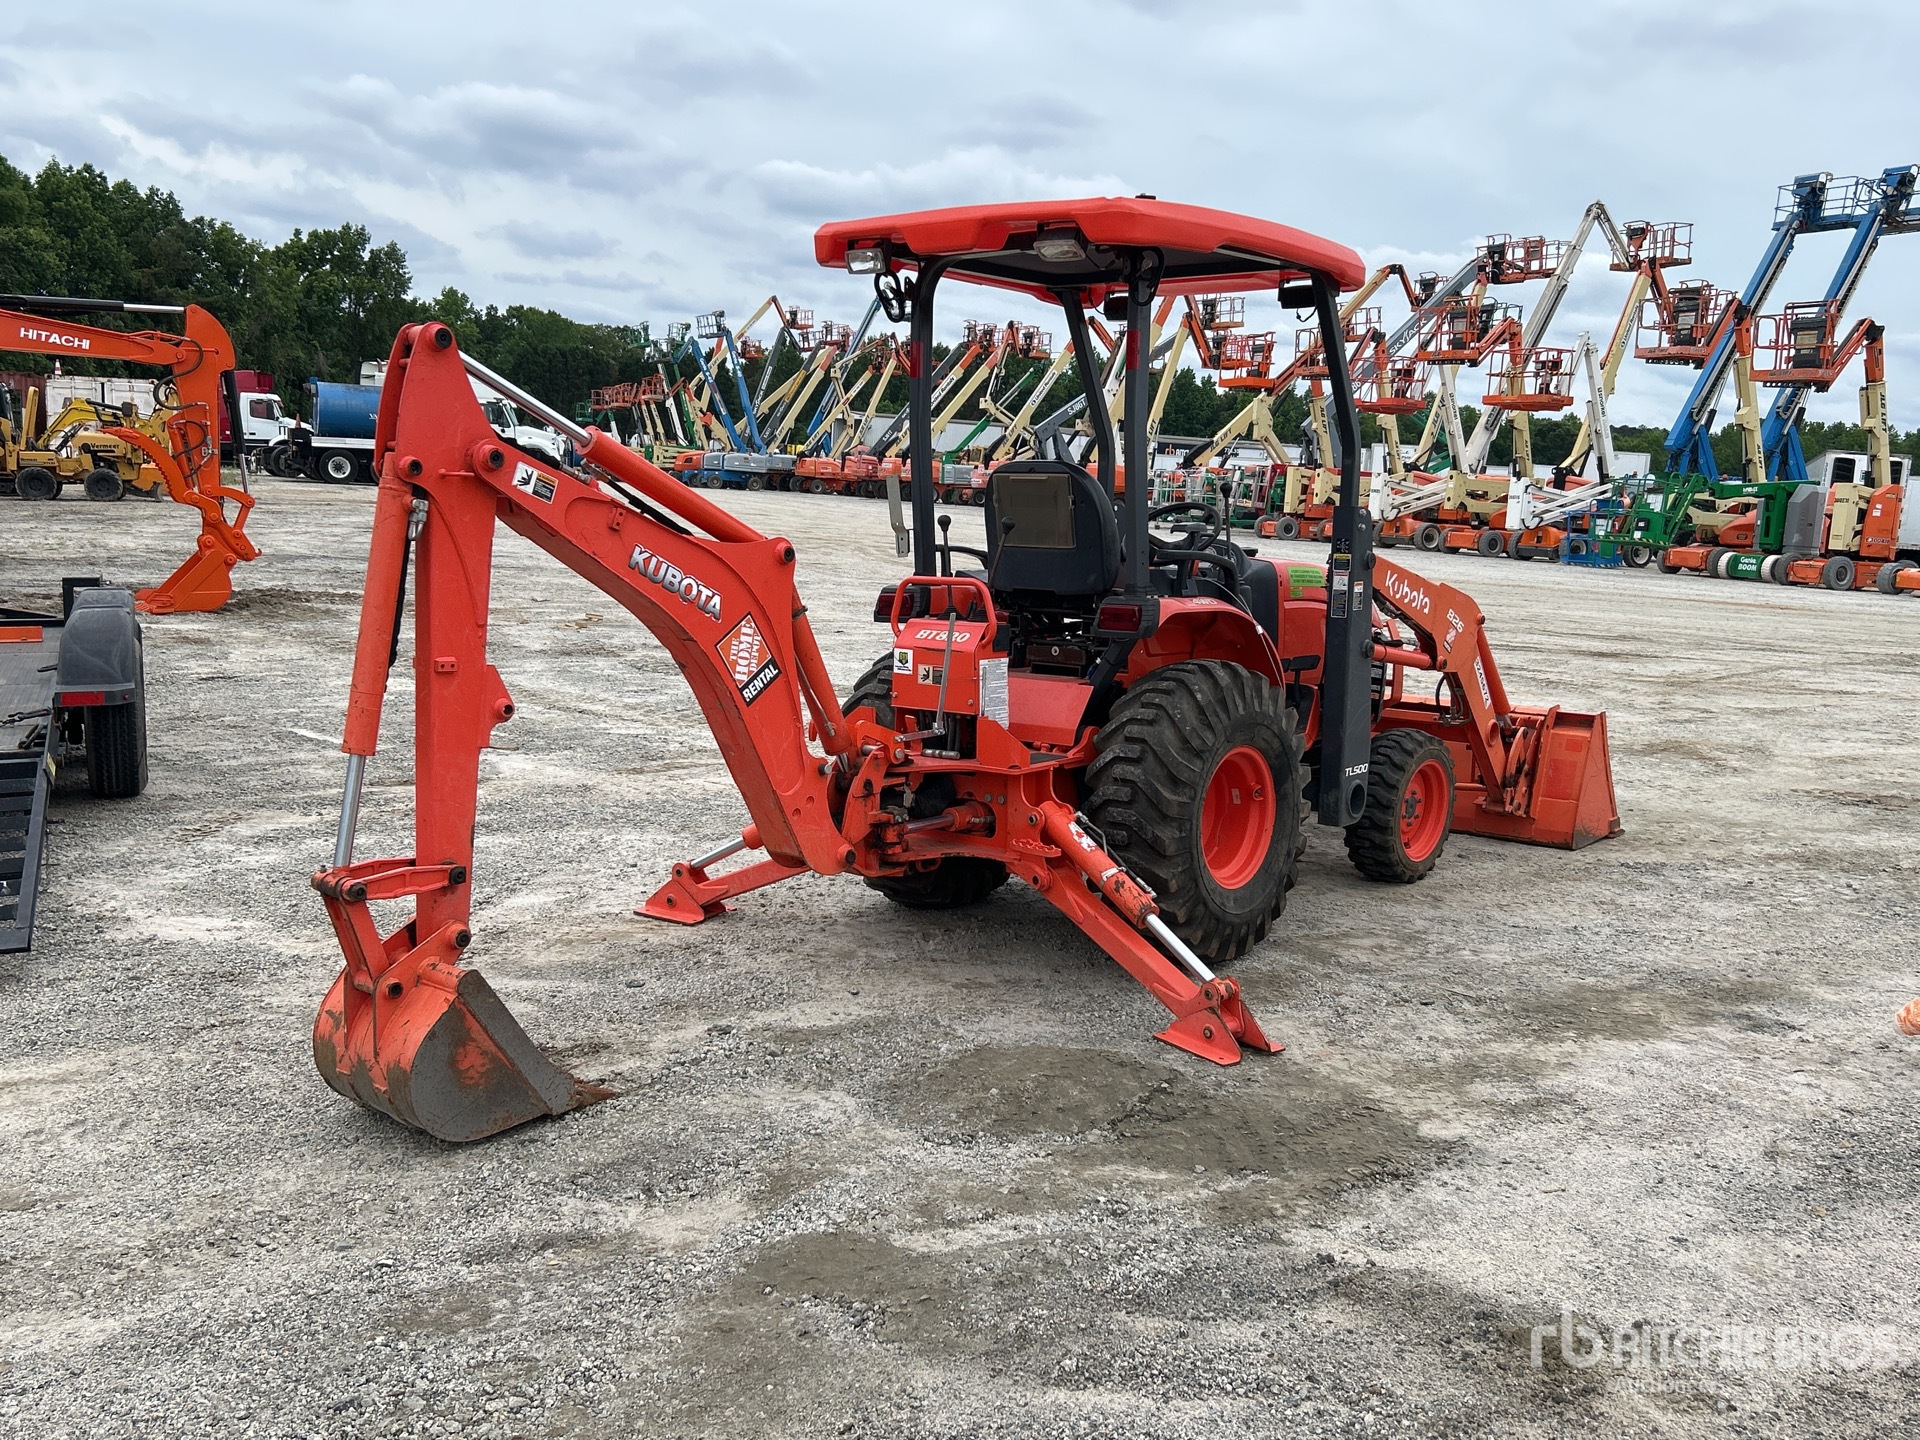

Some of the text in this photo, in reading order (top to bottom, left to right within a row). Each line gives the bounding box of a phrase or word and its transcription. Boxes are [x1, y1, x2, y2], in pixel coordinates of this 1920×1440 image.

[19, 327, 91, 350] HITACHI
[1389, 317, 1428, 355] SKYJACK
[1598, 393, 1606, 418] snorkel
[1148, 419, 1157, 436] LIFT
[1432, 410, 1441, 428] JLG
[1880, 412, 1888, 434] LIFT
[1220, 427, 1232, 442] LIFT
[90, 442, 120, 450] Vermeer
[1737, 563, 1757, 571] BOOM
[1740, 556, 1757, 564] Genie
[628, 543, 723, 623] KUBOTA
[1385, 570, 1430, 614] Kubota
[915, 629, 971, 643] BT820
[729, 637, 740, 662] THE
[734, 620, 755, 681] HOME
[748, 633, 761, 673] DEPOT
[742, 664, 779, 702] RENTAL
[1344, 763, 1369, 777] TL500
